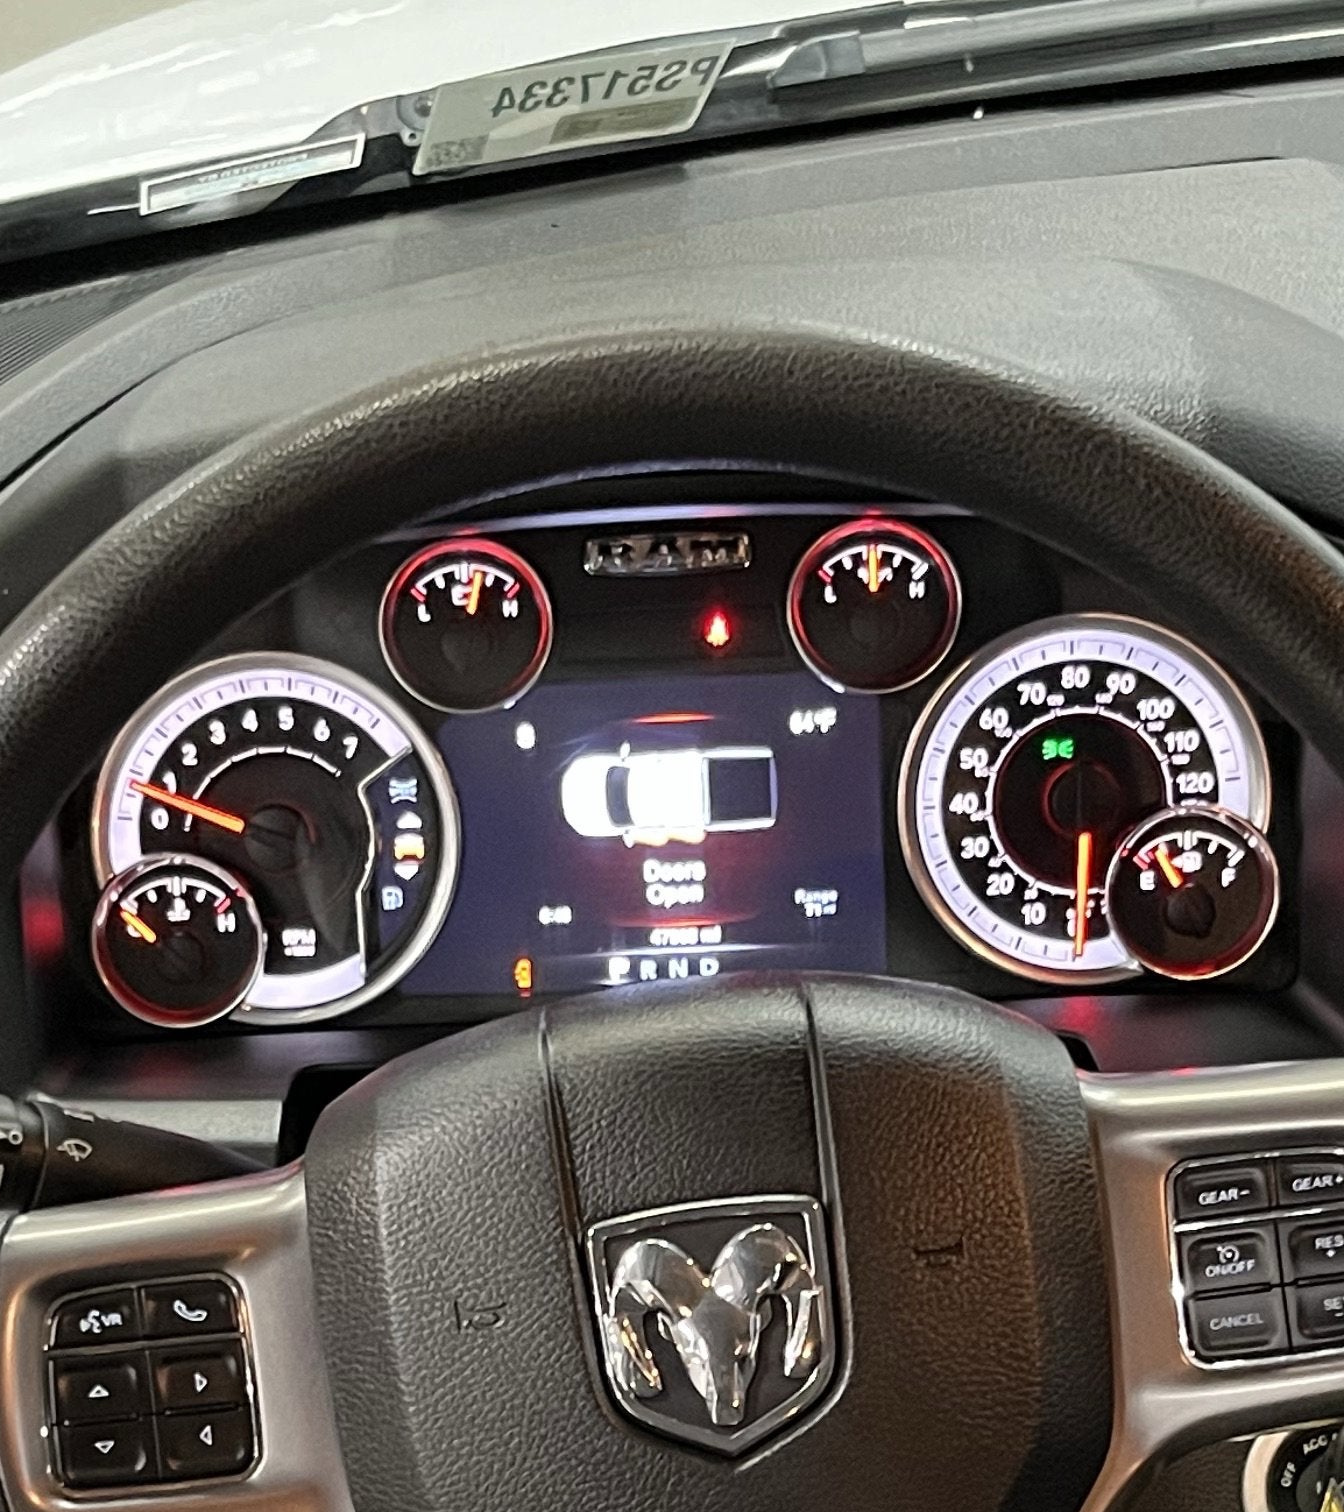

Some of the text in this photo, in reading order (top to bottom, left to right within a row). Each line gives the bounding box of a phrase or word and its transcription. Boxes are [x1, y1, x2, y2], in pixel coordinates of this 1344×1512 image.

[1060, 665, 1091, 690] 80
[1106, 672, 1136, 695] 90
[1017, 681, 1047, 706] 70
[241, 708, 259, 732] 4
[277, 706, 295, 731] 5
[979, 708, 1009, 730] 60
[1136, 697, 1175, 721] 100
[208, 720, 227, 745] 3
[313, 718, 331, 742] 6
[1163, 729, 1200, 753] 110
[181, 743, 198, 766] 2
[342, 734, 359, 759] 7
[960, 747, 989, 770] 50
[1176, 772, 1215, 794] 120
[949, 792, 979, 815] 40
[960, 836, 990, 859] 30
[986, 873, 1015, 896] 20
[1021, 901, 1046, 925] 10
[639, 959, 658, 981] R
[668, 957, 689, 979] N
[699, 957, 720, 977] D
[1209, 1311, 1264, 1332] CANCEL
